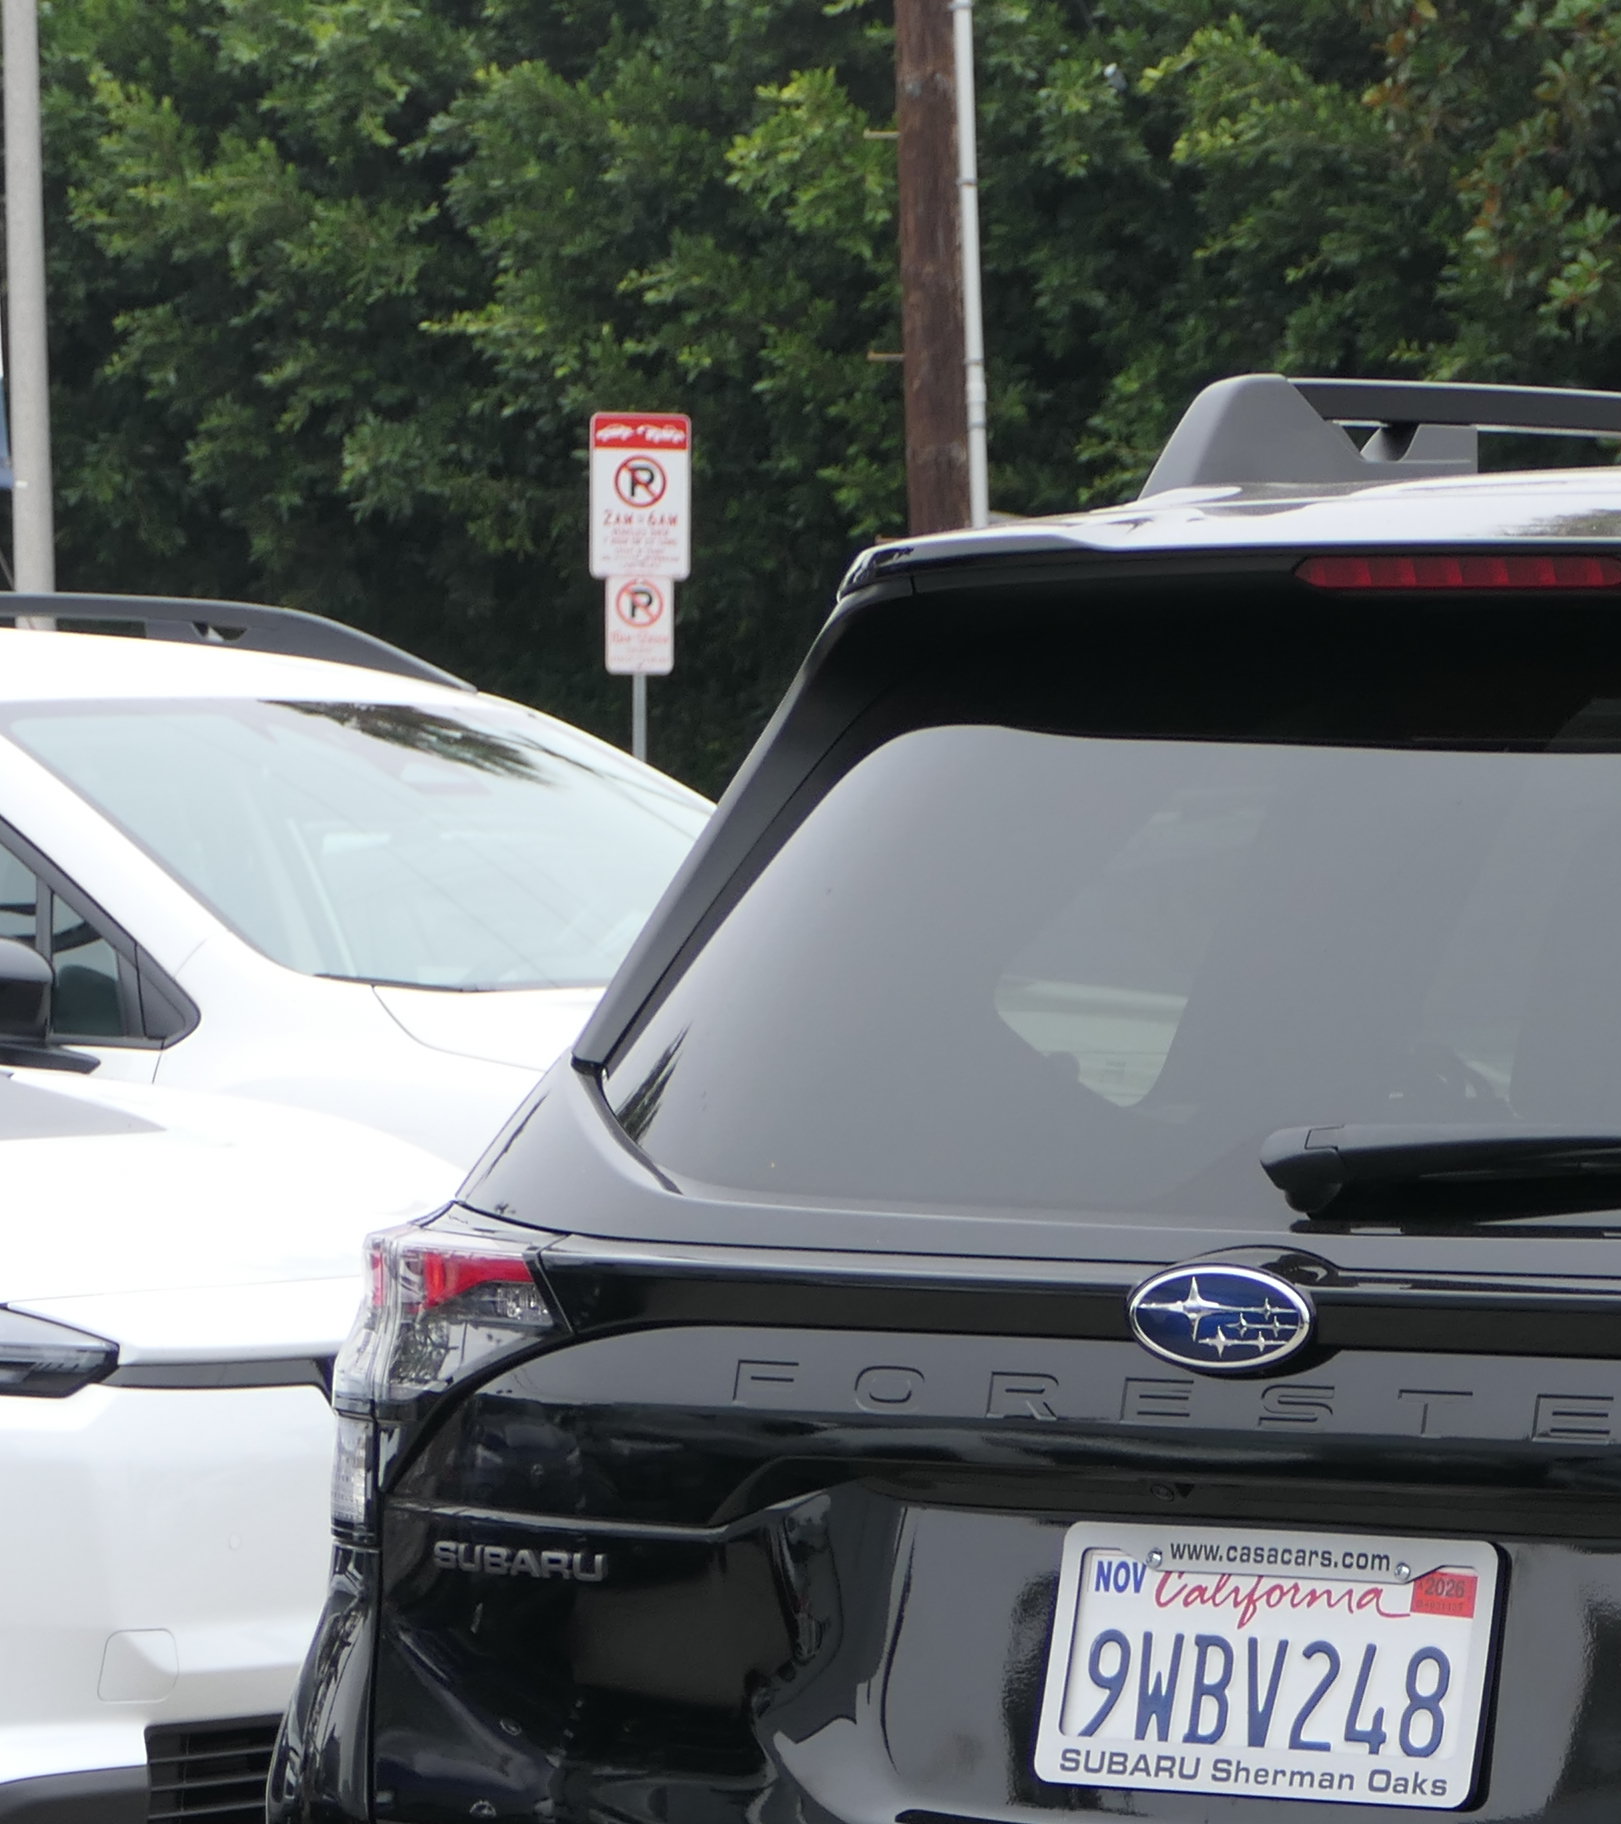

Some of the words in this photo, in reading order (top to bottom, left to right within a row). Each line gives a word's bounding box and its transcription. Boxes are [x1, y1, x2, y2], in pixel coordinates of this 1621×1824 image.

[433, 1540, 609, 1582] SUBARU
[1094, 1560, 1148, 1594] NOV
[1170, 1542, 1391, 1572] www.casacars.com
[1154, 1570, 1412, 1630] California
[1425, 1577, 1466, 1598] 2026
[1077, 1628, 1451, 1759] 9WBV248
[1059, 1748, 1200, 1781] SUBARU
[1211, 1758, 1355, 1793] Sherman
[1367, 1768, 1448, 1797] Oaks
